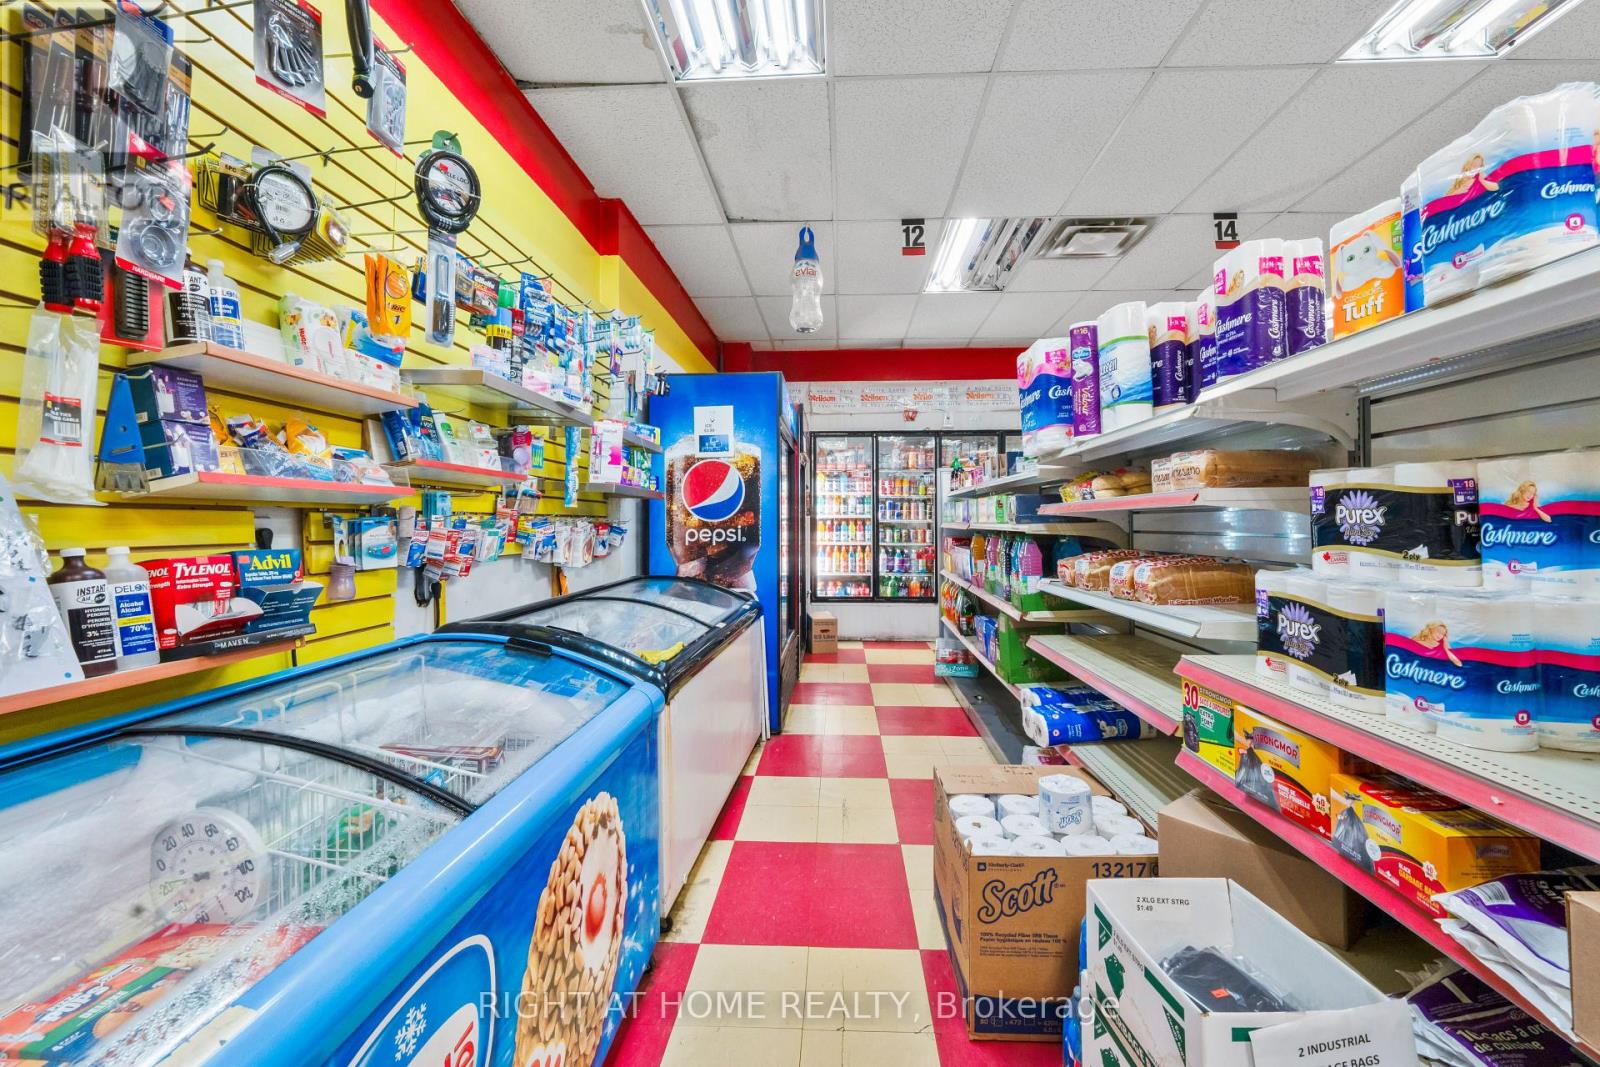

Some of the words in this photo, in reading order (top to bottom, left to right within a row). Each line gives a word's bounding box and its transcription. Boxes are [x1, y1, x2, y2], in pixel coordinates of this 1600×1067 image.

[902, 226, 925, 248] 12
[1214, 220, 1238, 241] 14
[1421, 198, 1507, 257] Cashmere
[1343, 292, 1385, 322] Tuff
[1215, 312, 1253, 338] Cashmere
[1335, 503, 1388, 527] Purex
[685, 526, 742, 546] pepsi
[1481, 522, 1557, 549] Cashmere
[173, 562, 231, 579] TYLENOL
[250, 553, 292, 571] Advil
[77, 583, 106, 597] INSTANT
[1277, 612, 1322, 646] Purex
[1386, 652, 1467, 690] Cashmere
[1184, 682, 1199, 710] 30
[1254, 732, 1299, 759] STRONGMOR
[182, 823, 195, 838] 40
[204, 823, 219, 838] 60
[163, 836, 177, 852] 20
[156, 859, 166, 872] 0
[1092, 862, 1146, 878] 13217
[977, 867, 1058, 924] Scott
[1298, 1047, 1305, 1057] 2
[1307, 1033, 1372, 1056] INDUSTRIAL
[1351, 1054, 1380, 1067] BAGS
